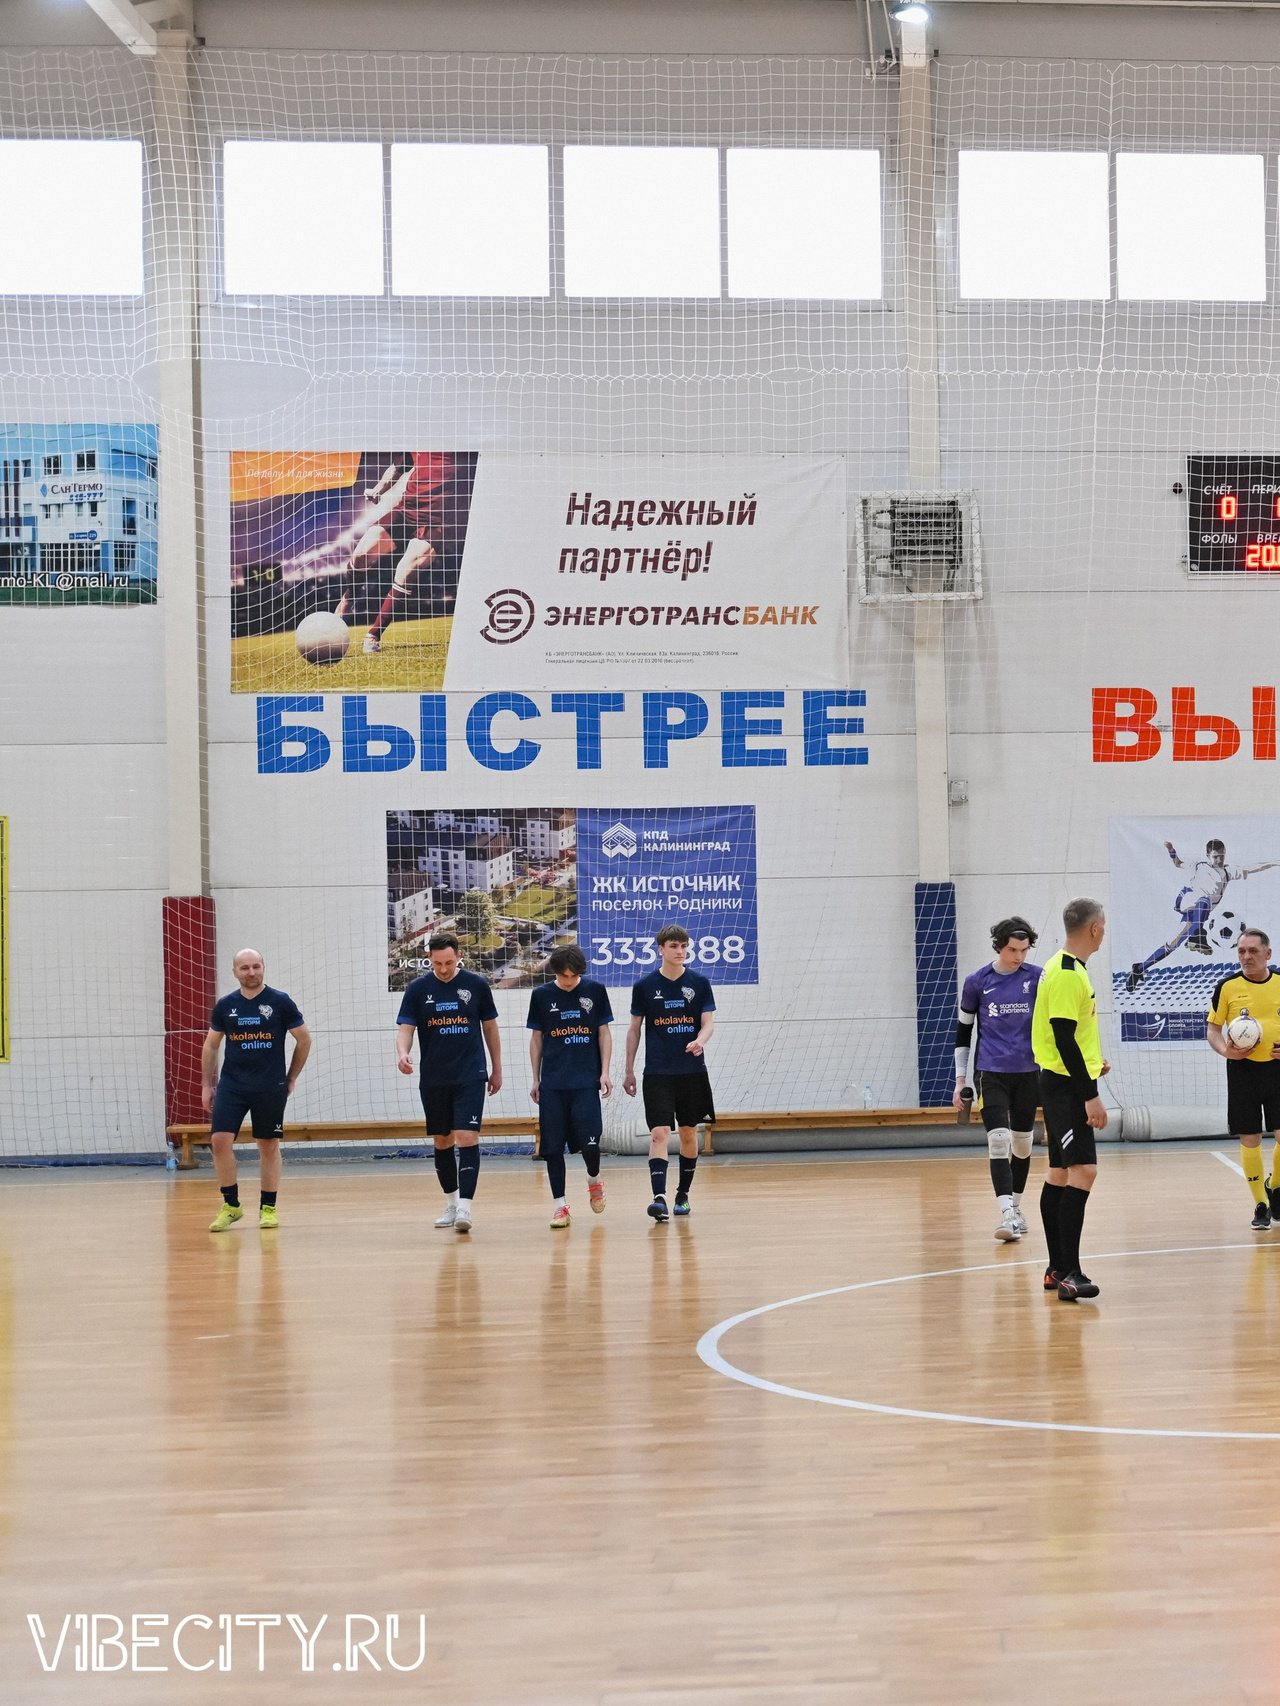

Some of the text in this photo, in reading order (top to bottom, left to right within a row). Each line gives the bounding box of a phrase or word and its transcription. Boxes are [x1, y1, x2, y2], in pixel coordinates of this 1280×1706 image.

[1203, 482, 1233, 495] СЧЁТ
[565, 492, 758, 531] Надежный
[1221, 496, 1237, 519] 0
[1201, 533, 1238, 544] ФОЛЫ
[557, 540, 713, 581] партнёр!
[543, 605, 820, 627] ЭНЕРГОТРАНСБАНК
[256, 689, 869, 774] БЫСТРЕЕ
[643, 830, 669, 841] КПД
[643, 841, 731, 852] КАЛИНИНГРАД
[592, 875, 741, 893] ЖК ИСТОЧНИК
[592, 895, 743, 912] поселок Родники
[591, 937, 657, 966] 333
[439, 1025, 469, 1035] online
[667, 1025, 694, 1034] online
[241, 1041, 272, 1050] online
